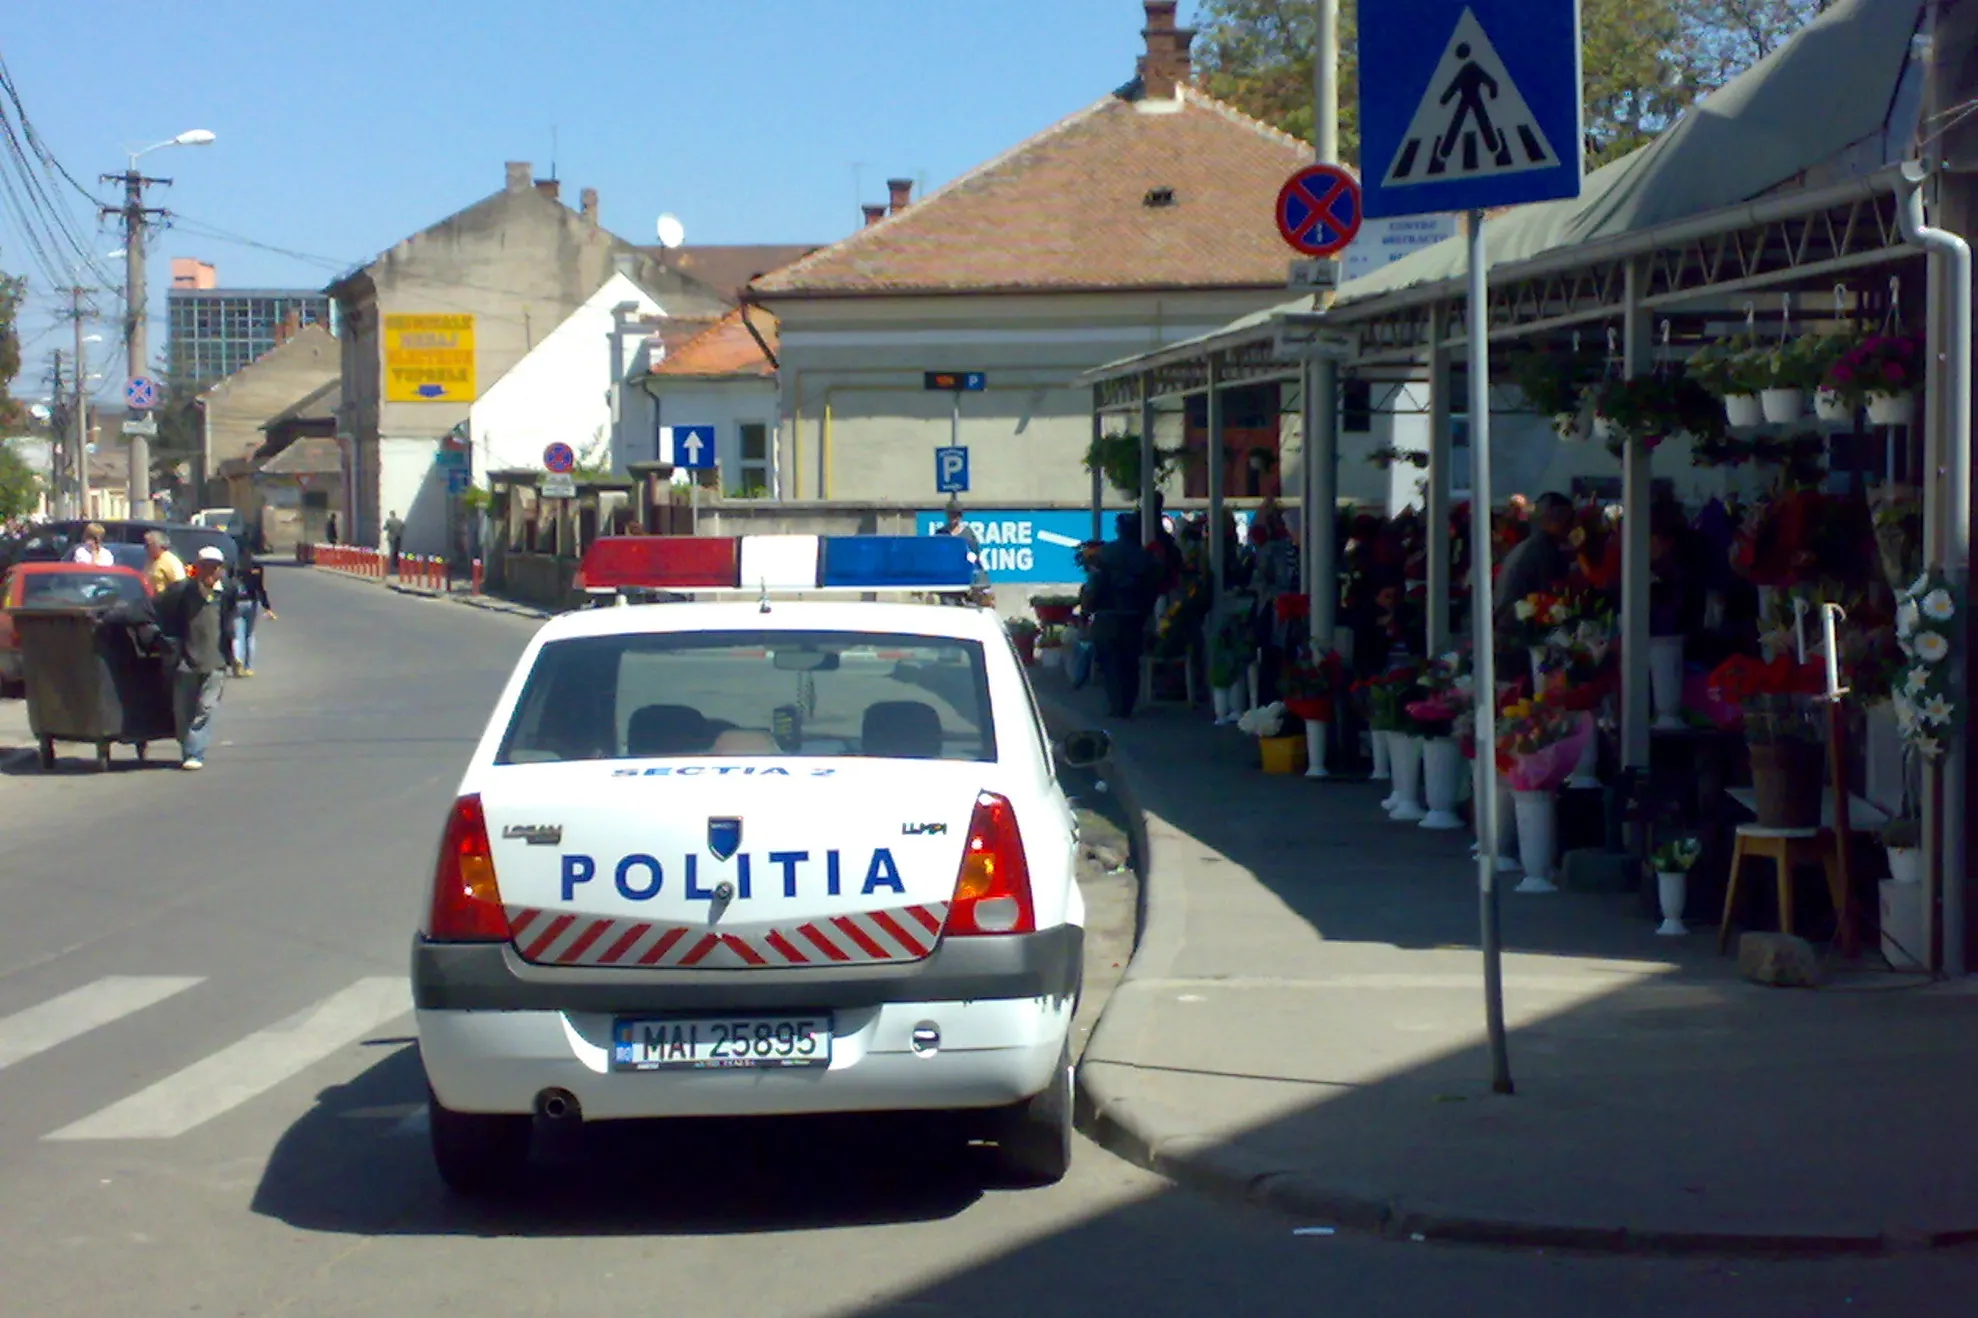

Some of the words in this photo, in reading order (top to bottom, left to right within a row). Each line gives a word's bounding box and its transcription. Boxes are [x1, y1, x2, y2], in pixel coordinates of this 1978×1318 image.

[968, 374, 979, 387] P
[943, 455, 964, 483] P
[928, 521, 1033, 544] IRARE
[611, 766, 790, 777] SECTIA
[810, 767, 837, 777] 2
[560, 847, 906, 901] POLITIA
[642, 1025, 696, 1060] MAI
[709, 1021, 817, 1058] 25895
